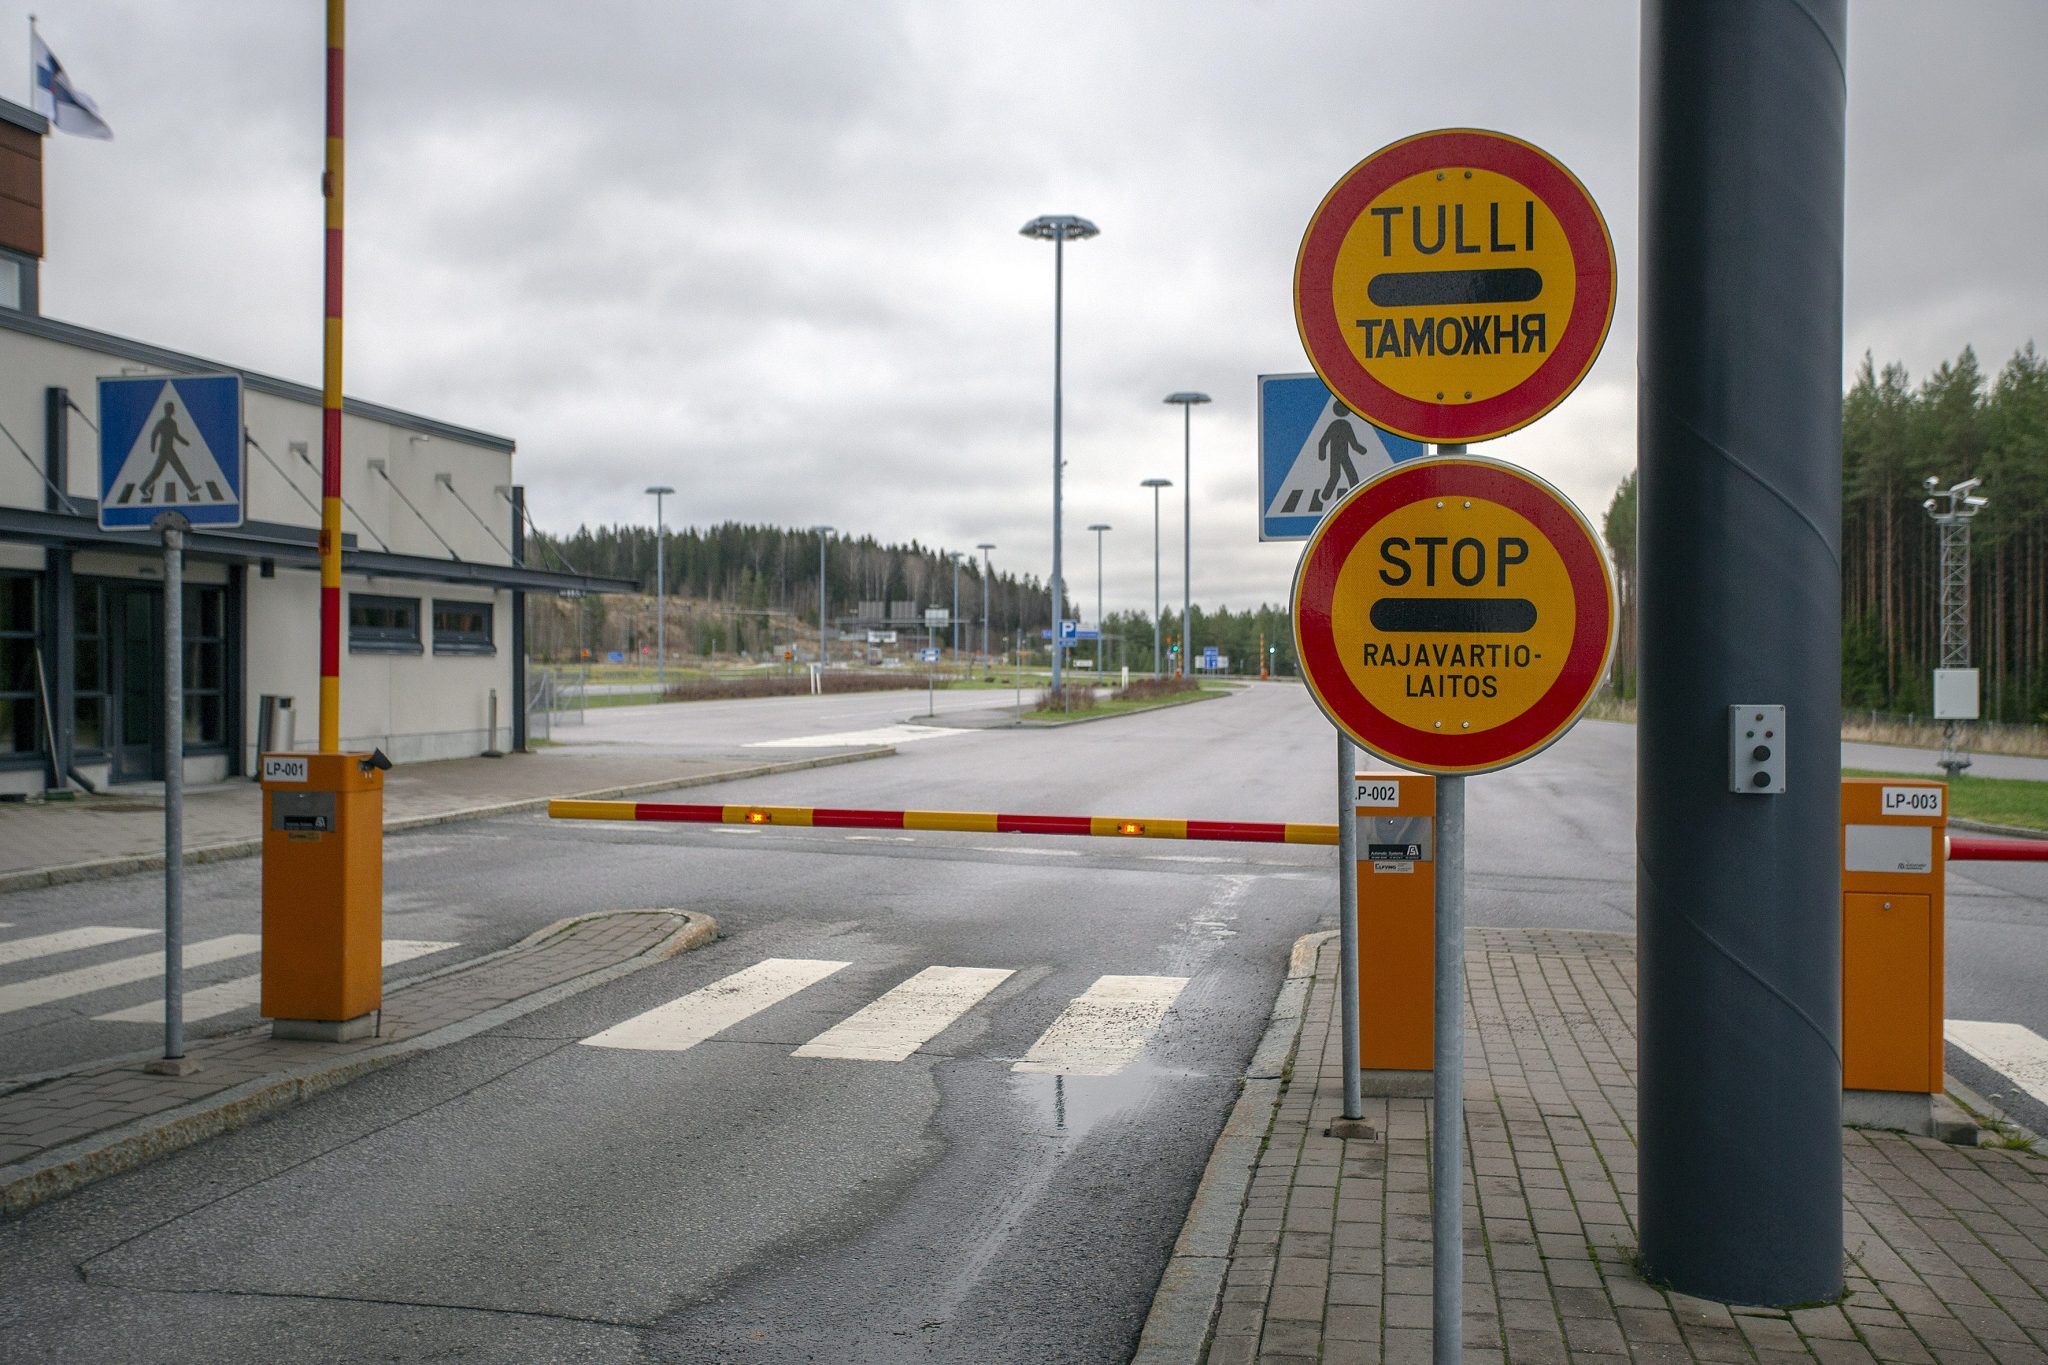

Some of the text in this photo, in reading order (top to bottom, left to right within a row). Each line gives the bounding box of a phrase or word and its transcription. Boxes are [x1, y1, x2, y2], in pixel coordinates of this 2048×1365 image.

[1371, 201, 1534, 256] TULLI
[1356, 313, 1546, 358] ТАМОЖНЯ
[1378, 537, 1529, 587] STOP
[1363, 643, 1542, 668] RAJAVARTIO-
[1406, 674, 1498, 698] LAITOS
[266, 762, 304, 776] LP-001
[1355, 786, 1395, 801] P-002
[1886, 793, 1938, 810] LP-003
